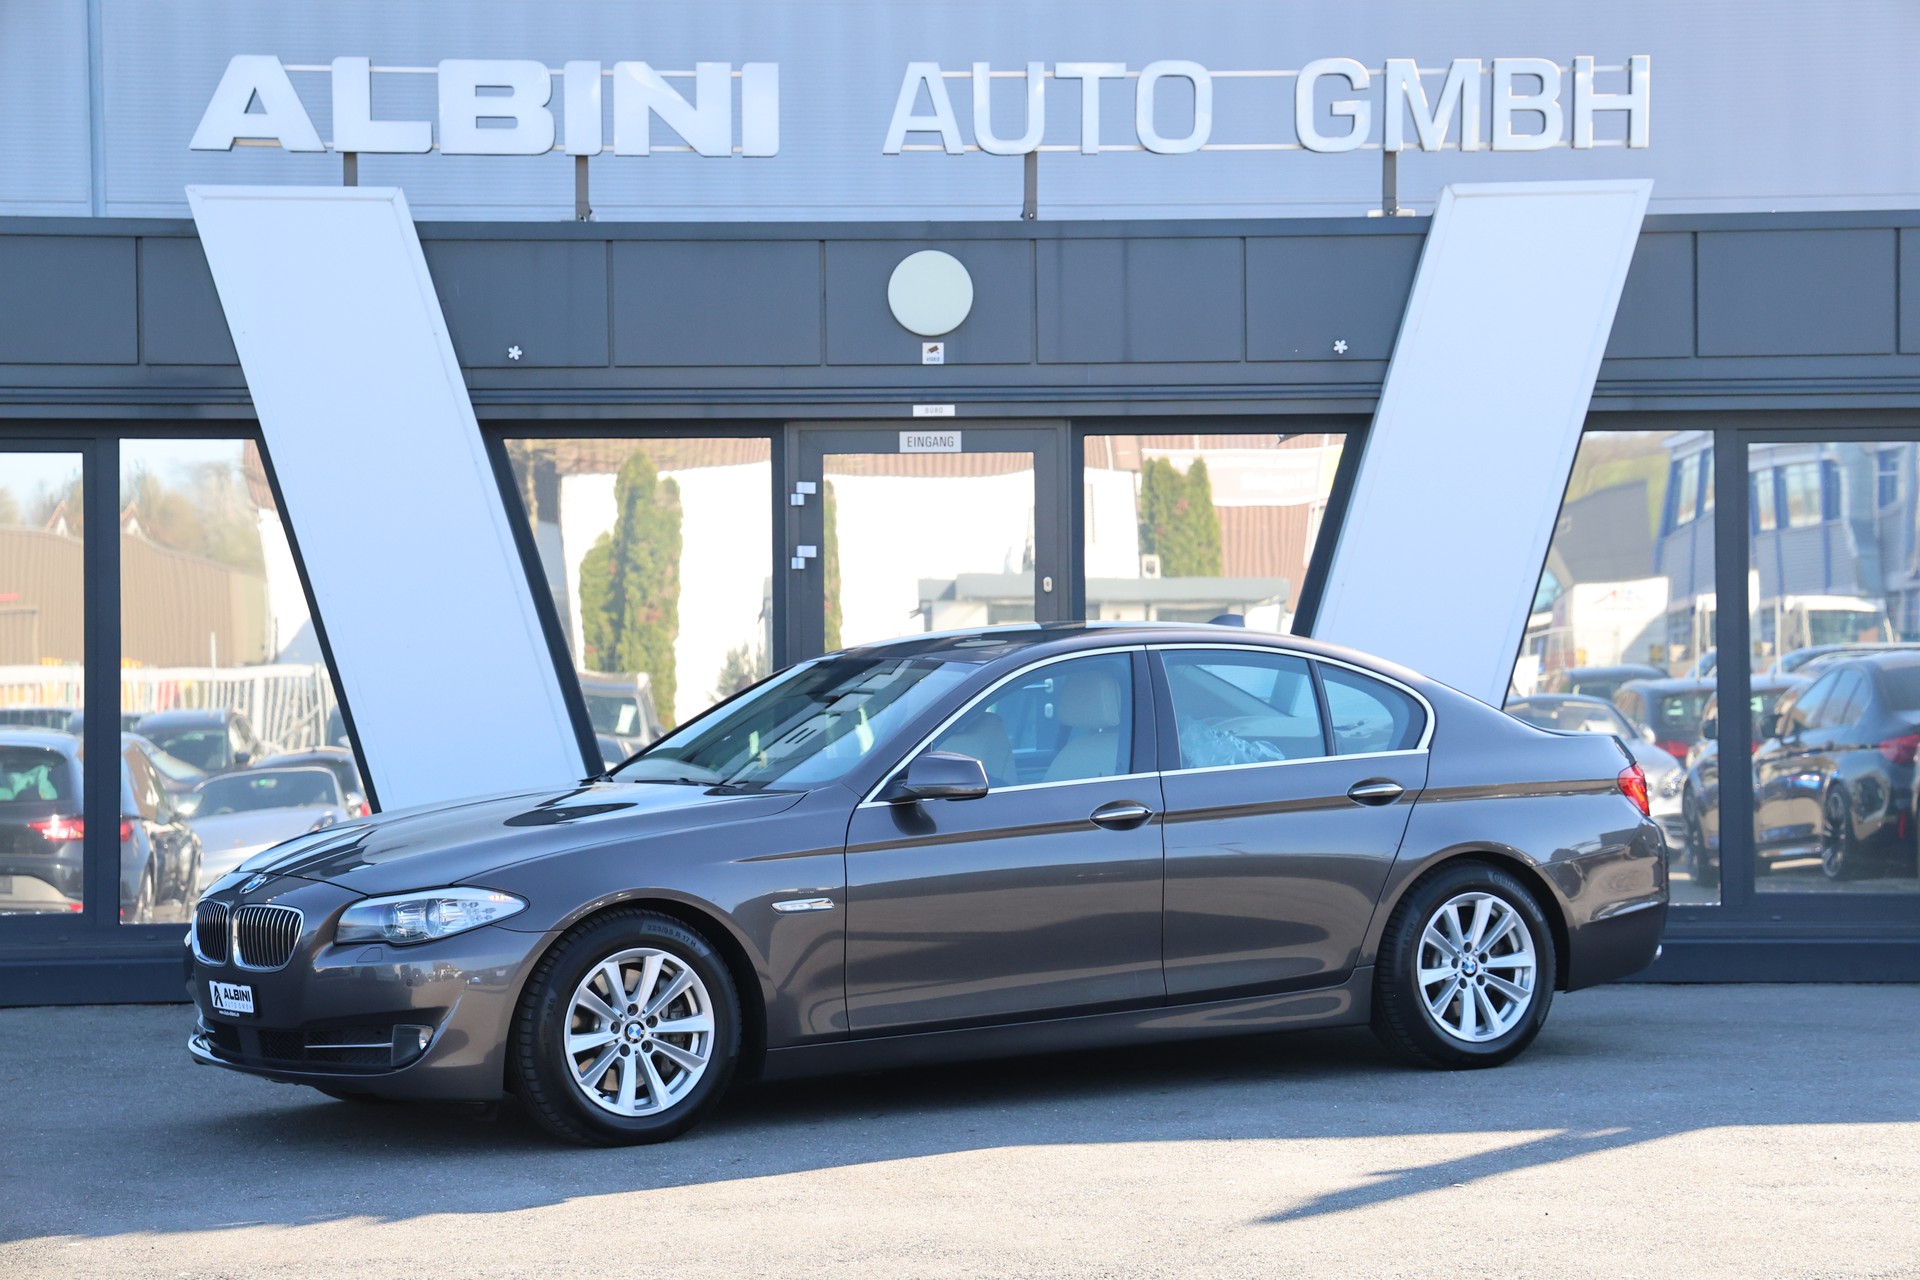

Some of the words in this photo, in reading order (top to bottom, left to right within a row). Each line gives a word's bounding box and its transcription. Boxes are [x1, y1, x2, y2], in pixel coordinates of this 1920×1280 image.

[188, 54, 780, 157] ALBINI
[882, 59, 1213, 156] AUTO
[1294, 54, 1651, 154] GMBH
[907, 436, 954, 448] EINGANG
[224, 987, 251, 1002] ALBINI
